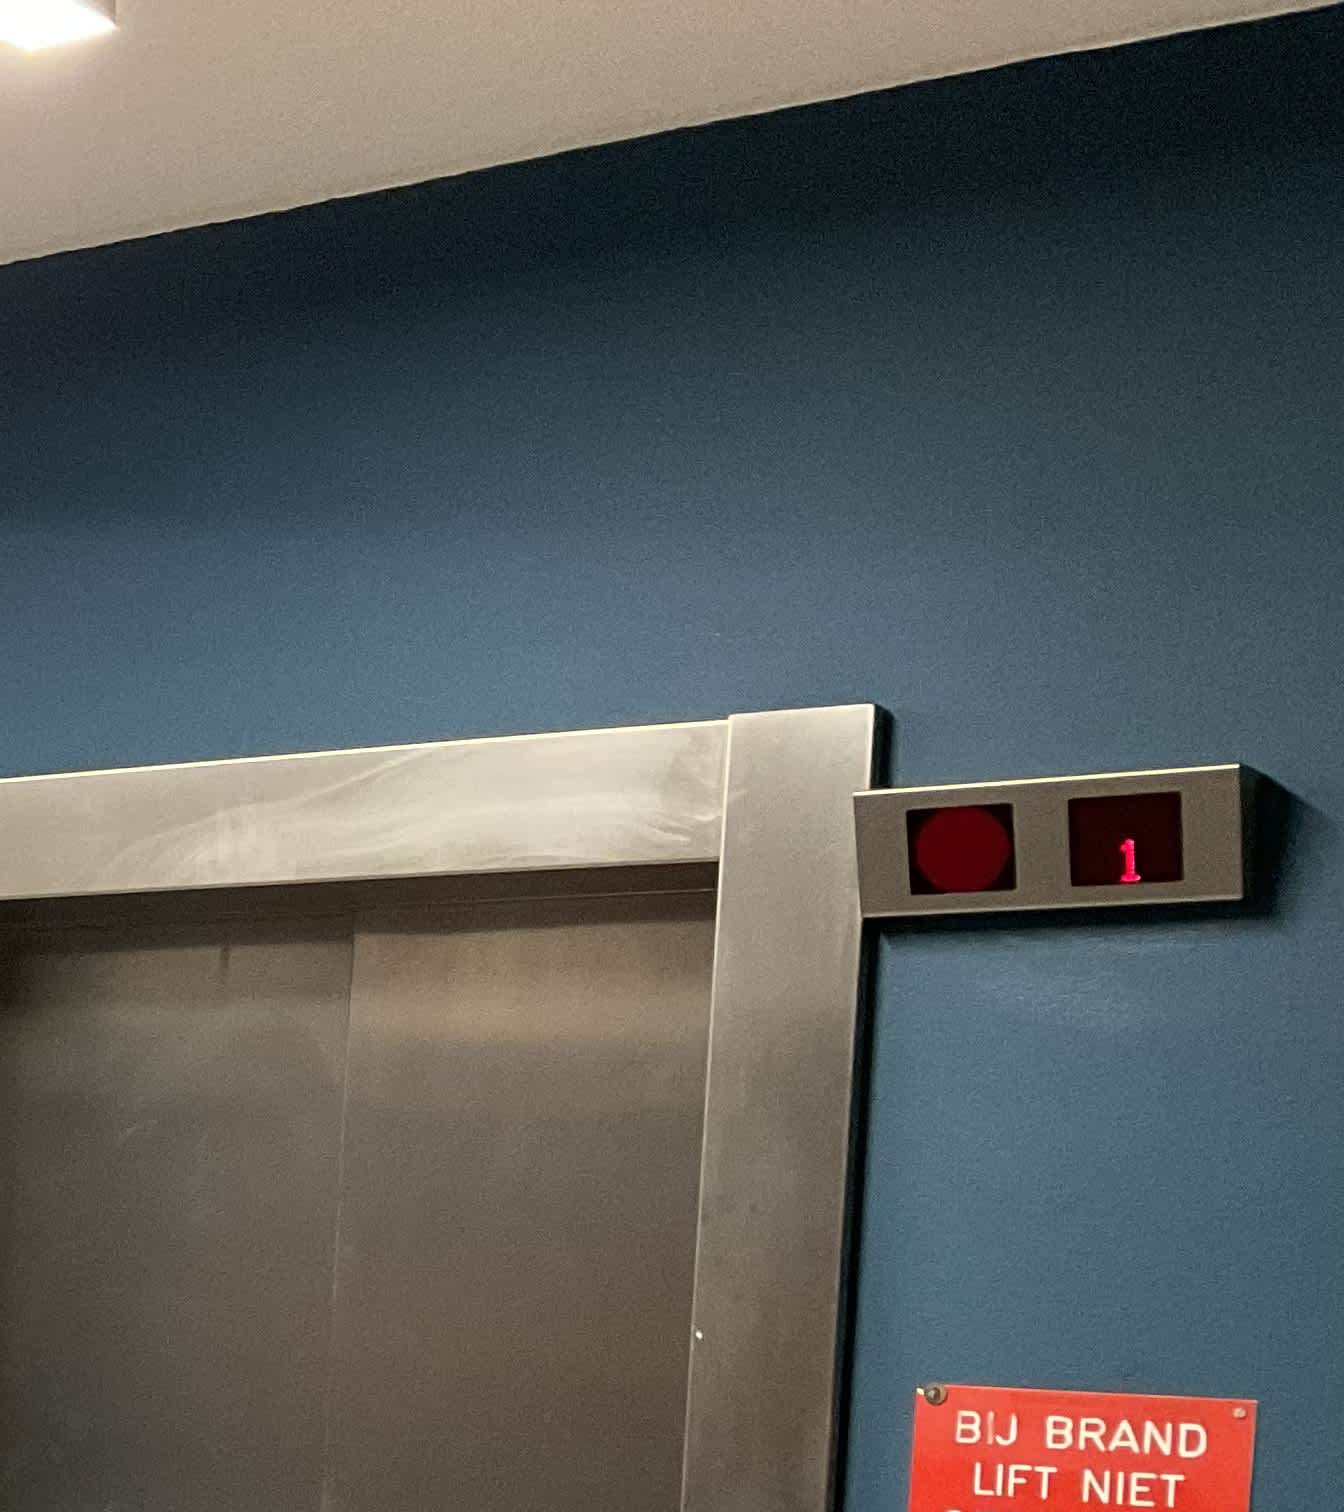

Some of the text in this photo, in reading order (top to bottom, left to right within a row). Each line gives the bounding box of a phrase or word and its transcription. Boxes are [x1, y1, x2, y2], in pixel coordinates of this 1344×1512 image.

[1120, 838, 1141, 883] 1
[955, 1410, 1208, 1459] BIJ BRAND
[973, 1462, 1185, 1509] LIFT NIET
